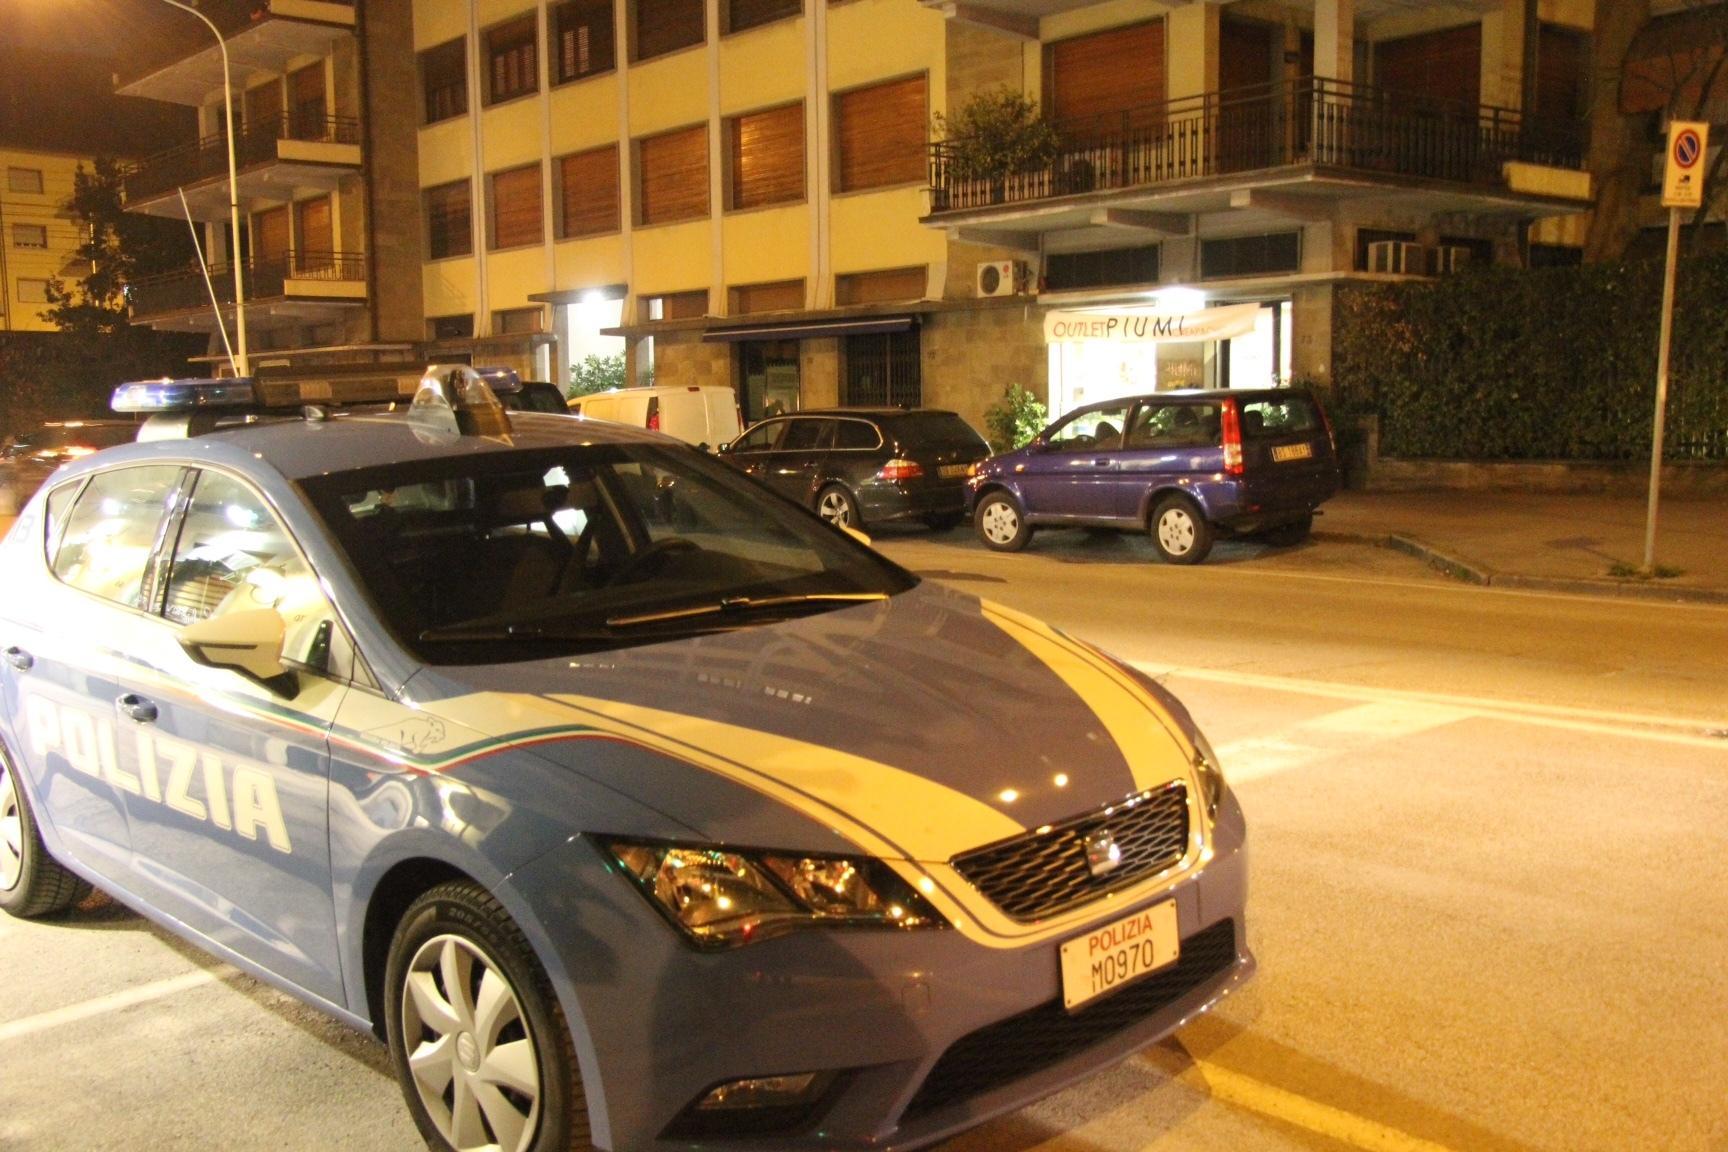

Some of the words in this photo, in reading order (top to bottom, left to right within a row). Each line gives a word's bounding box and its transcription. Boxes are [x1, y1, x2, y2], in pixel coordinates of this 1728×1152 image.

[1053, 321, 1106, 337] OUTLET
[1105, 315, 1185, 337] PIUMI
[26, 692, 292, 854] POLIZIA
[1089, 914, 1152, 957] POLIZIA
[1092, 939, 1154, 993] M0970
